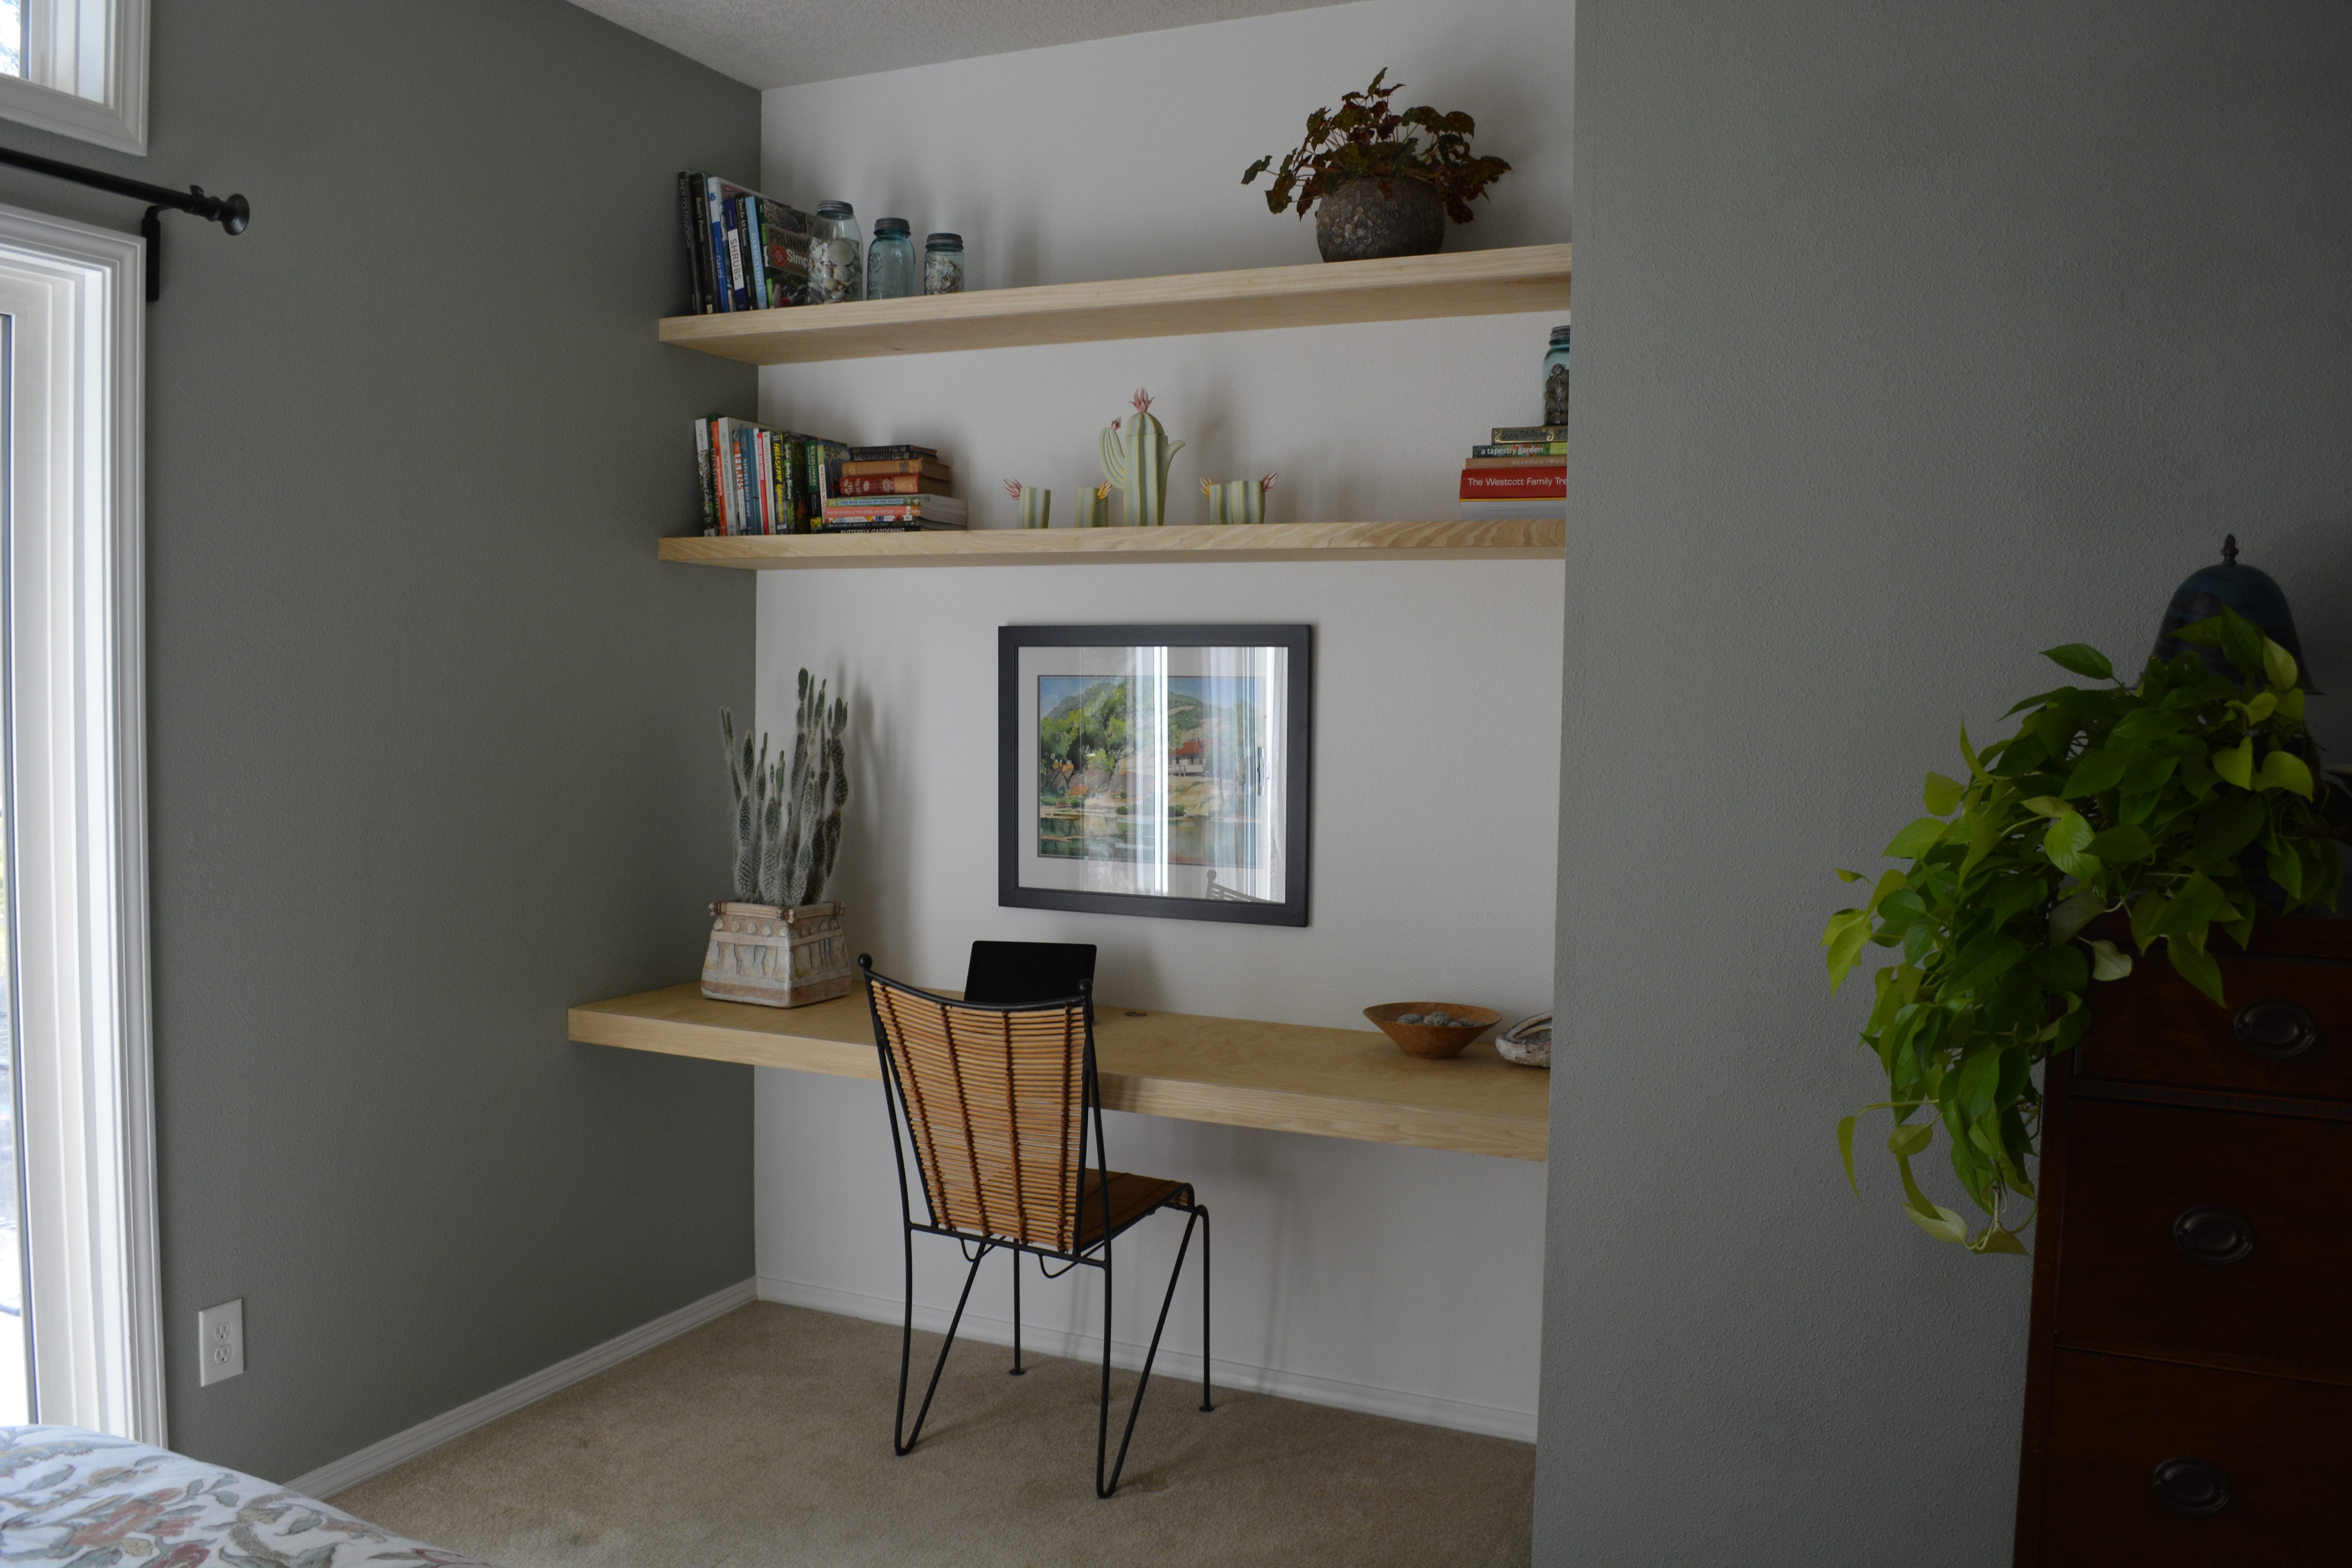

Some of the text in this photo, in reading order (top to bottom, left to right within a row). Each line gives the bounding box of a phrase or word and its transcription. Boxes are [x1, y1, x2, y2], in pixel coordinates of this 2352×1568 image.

[681, 197, 691, 248] GOLDSWORTHY
[730, 238, 741, 280] SHRUBS
[752, 233, 762, 291] GARDENTOPIA
[1517, 446, 1543, 455] garden
[1520, 431, 1547, 441] ishiguro
[773, 443, 782, 482] HELLSTRIP
[1527, 477, 1552, 487] Family
